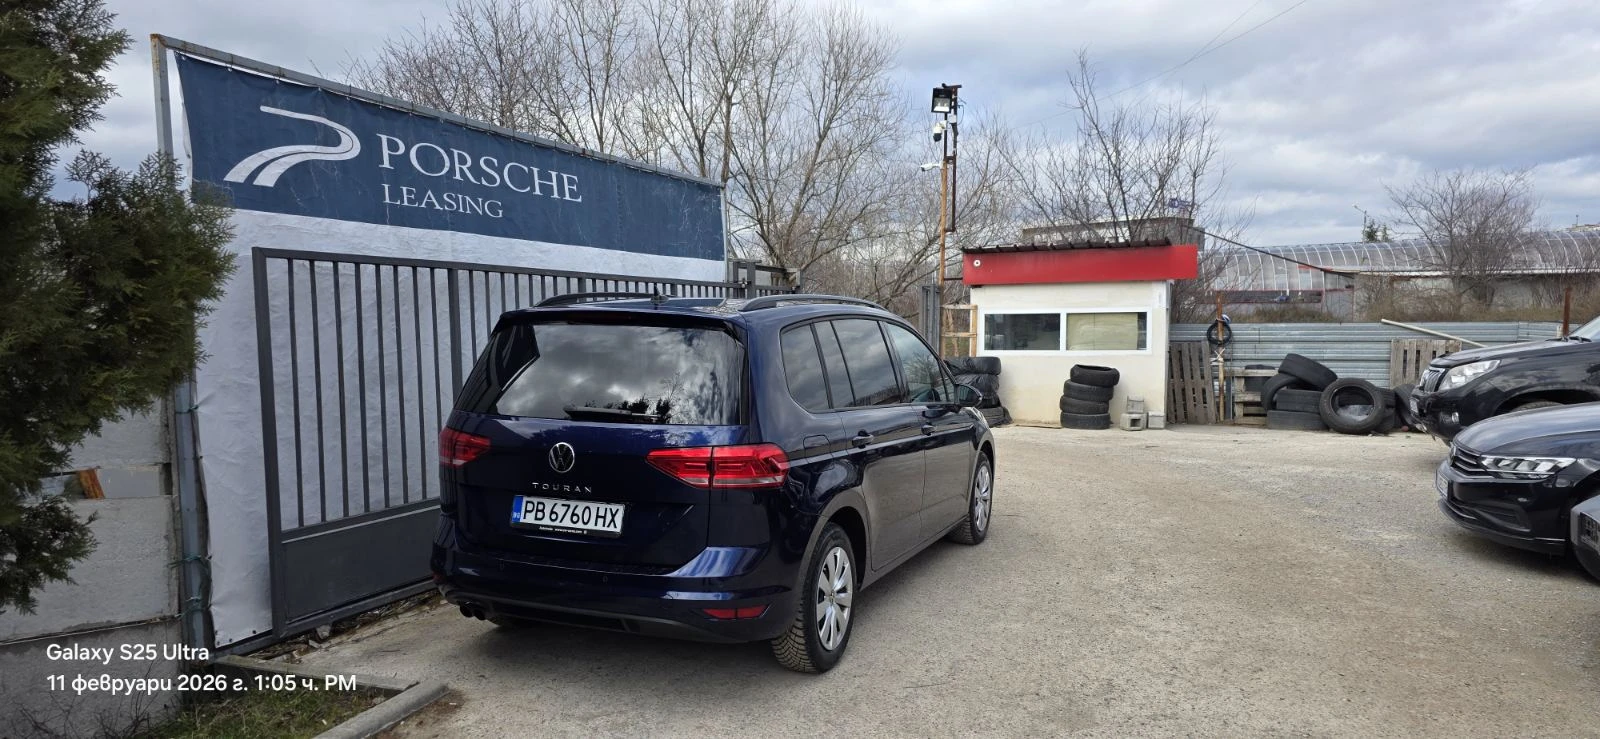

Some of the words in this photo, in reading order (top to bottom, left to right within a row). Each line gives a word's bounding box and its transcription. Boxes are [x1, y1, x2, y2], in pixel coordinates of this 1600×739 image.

[376, 133, 583, 203] PORSCHE
[382, 183, 504, 219] LEASING
[531, 482, 592, 493] TOURAN
[523, 500, 546, 521] PB
[549, 502, 592, 526] 6760
[594, 506, 620, 529] HX
